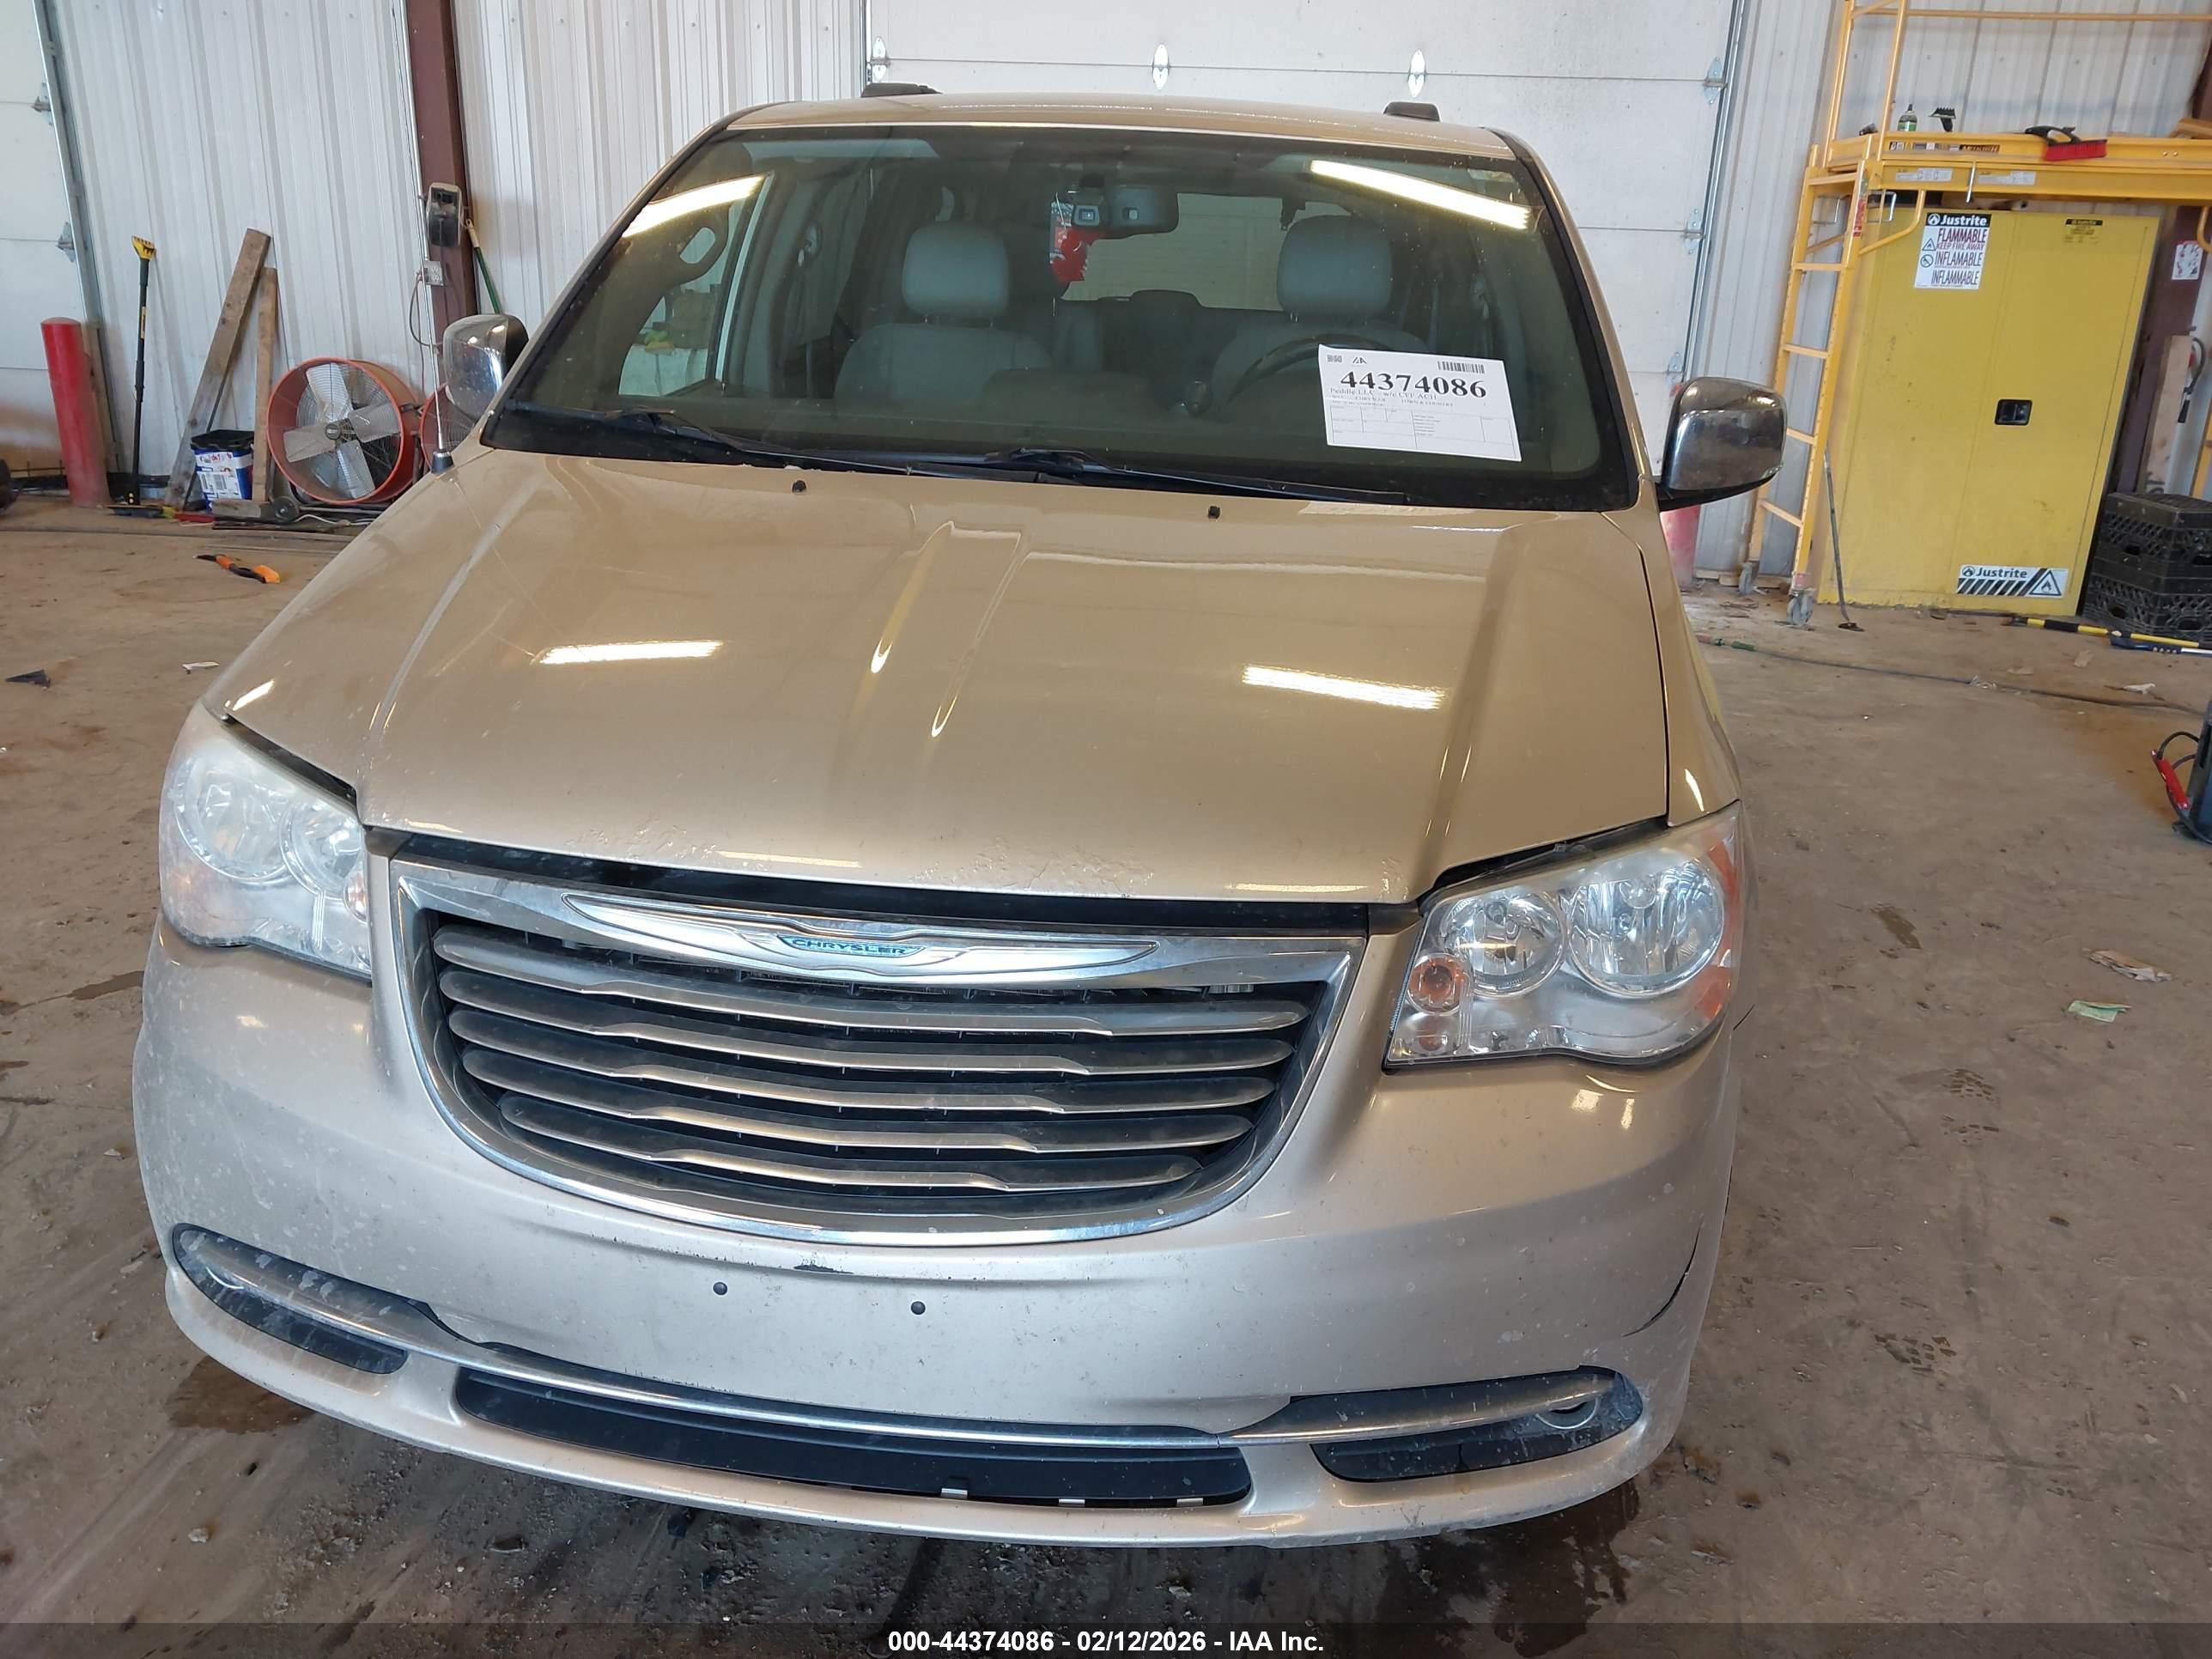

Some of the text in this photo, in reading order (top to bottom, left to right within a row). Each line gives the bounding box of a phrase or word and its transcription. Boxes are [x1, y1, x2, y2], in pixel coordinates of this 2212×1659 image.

[1941, 215, 1987, 226] Justrite
[1937, 228, 1988, 243] FLAMMABLE
[1934, 251, 1984, 266] INFLAMABLE
[1930, 270, 1980, 285] INFLAMMABLE
[1340, 371, 1486, 398] 44374086
[1976, 568, 2027, 578] Justrite
[792, 939, 906, 954] CHRYSLER
